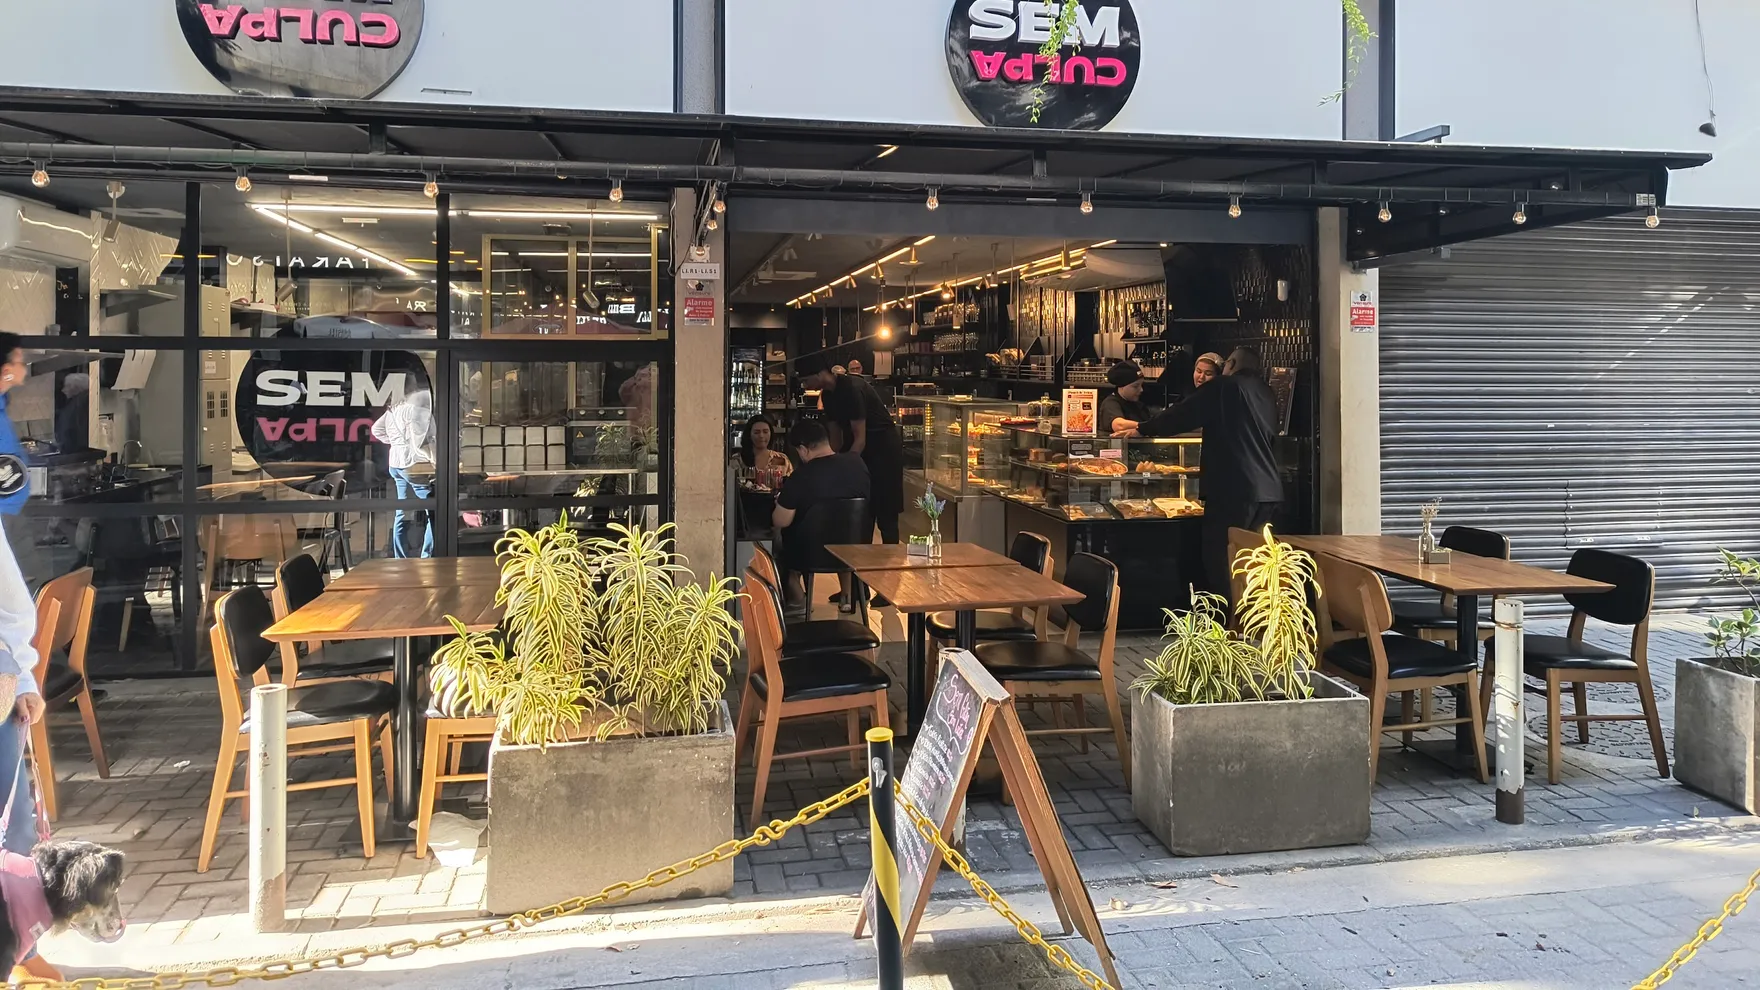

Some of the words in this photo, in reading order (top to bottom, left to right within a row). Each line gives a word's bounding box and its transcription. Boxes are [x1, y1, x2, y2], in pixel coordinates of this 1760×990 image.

[199, 4, 401, 48] CULPA
[968, 0, 1120, 48] SEM
[968, 50, 1127, 87] CULPA
[255, 369, 407, 407] SEM
[256, 417, 378, 442] ULPA
